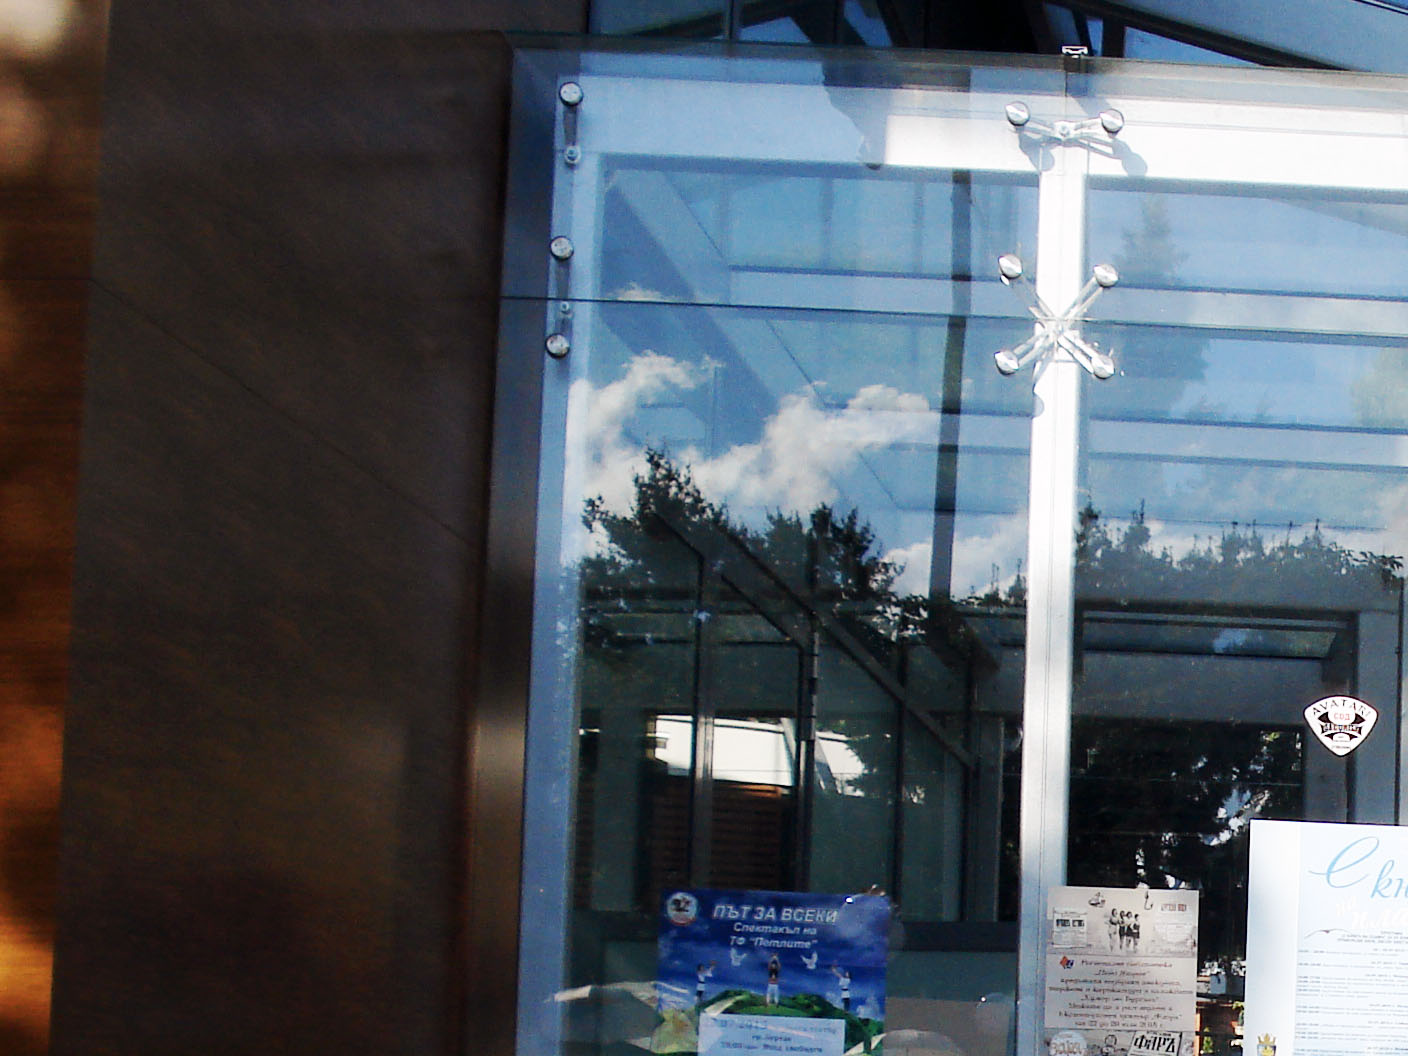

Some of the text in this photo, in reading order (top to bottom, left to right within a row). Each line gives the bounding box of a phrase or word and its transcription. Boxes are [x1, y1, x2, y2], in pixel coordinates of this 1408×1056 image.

[712, 904, 838, 924] ПЪТ ЗА ВСЕКИ
[802, 927, 817, 935] на
